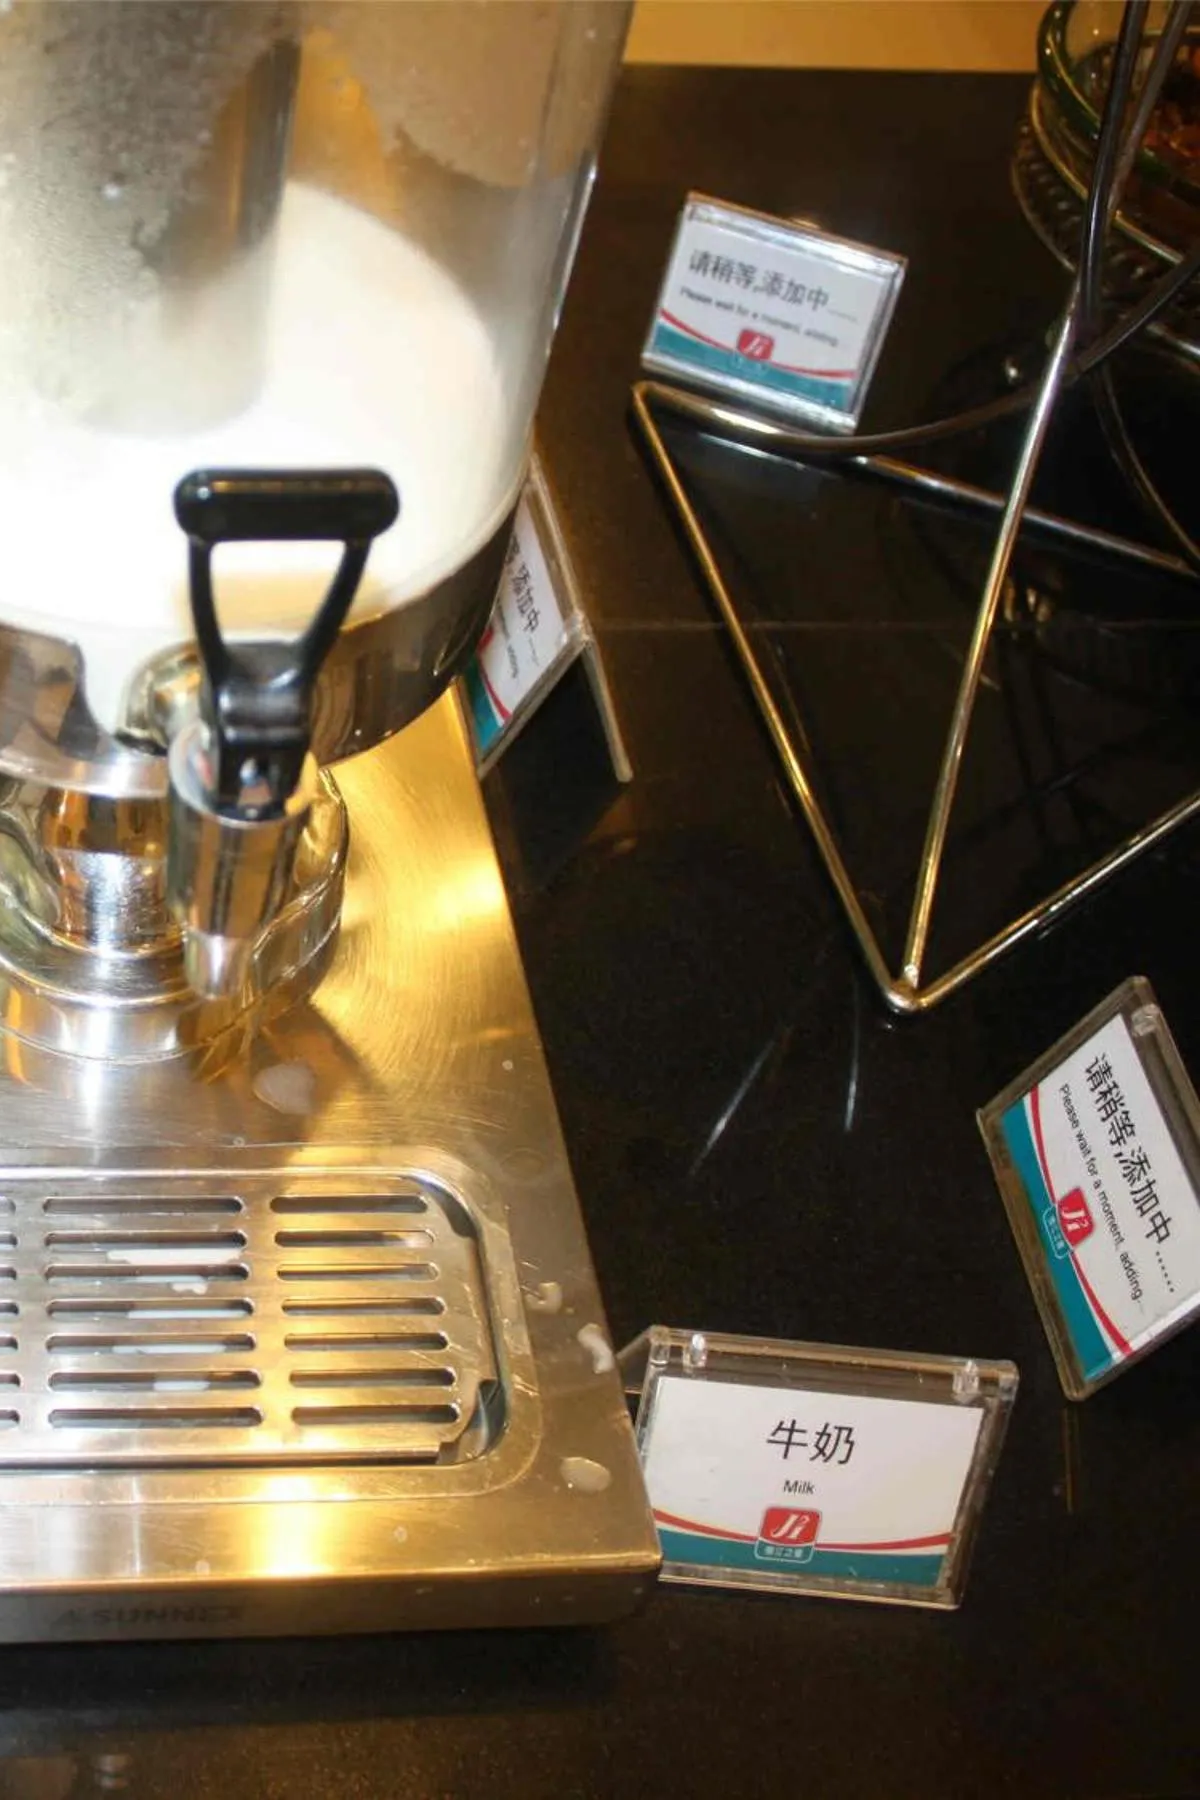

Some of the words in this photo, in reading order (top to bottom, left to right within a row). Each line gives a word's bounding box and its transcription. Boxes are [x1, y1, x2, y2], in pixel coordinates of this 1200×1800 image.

[1060, 1083, 1081, 1128] Please
[1077, 1130, 1092, 1155] wait
[1086, 1155, 1100, 1176] for
[766, 1419, 856, 1465] 牛奶
[783, 1479, 815, 1496] Milk
